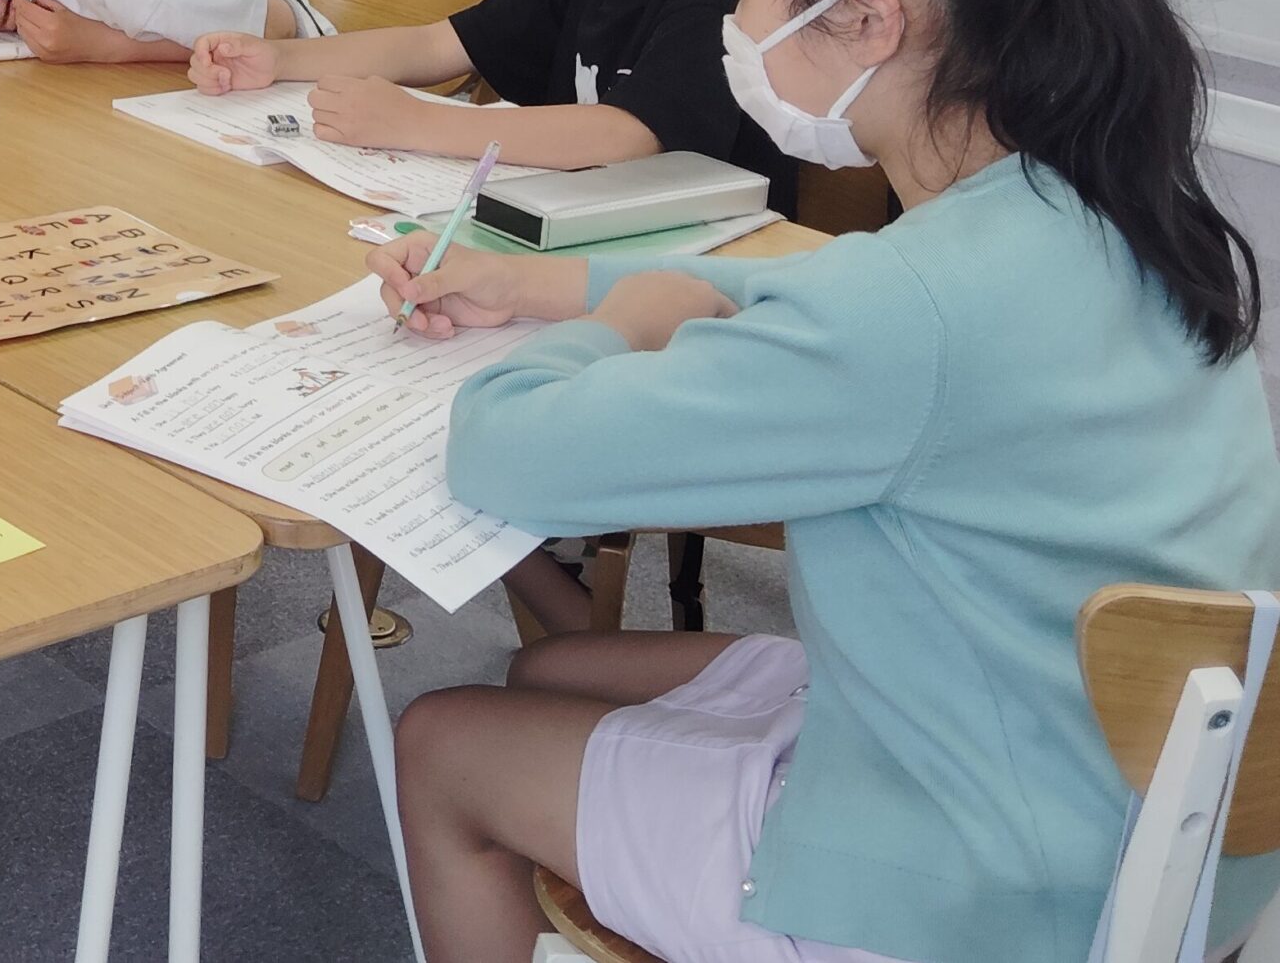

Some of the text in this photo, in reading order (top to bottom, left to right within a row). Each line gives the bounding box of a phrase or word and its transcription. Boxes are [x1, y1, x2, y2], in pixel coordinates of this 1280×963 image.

[40, 222, 68, 233] F
[71, 238, 98, 249] G
[99, 252, 129, 265] H
[85, 212, 251, 280] A B C D E
[0, 274, 28, 286] Q
[31, 286, 62, 299] R
[66, 298, 95, 311] S
[21, 248, 49, 260] K
[51, 265, 76, 277] L
[82, 274, 117, 289] M
[116, 287, 151, 300] N
[9, 309, 45, 323] X
[155, 352, 188, 374] Agreement
[156, 397, 168, 407] the
[169, 386, 188, 399] blanks
[188, 376, 201, 387] with
[245, 452, 258, 464] Fill
[263, 440, 277, 453] the
[273, 430, 291, 446] blanks
[291, 420, 304, 433] with
[279, 461, 294, 473] read
[331, 427, 349, 438] have
[438, 558, 453, 570] They
